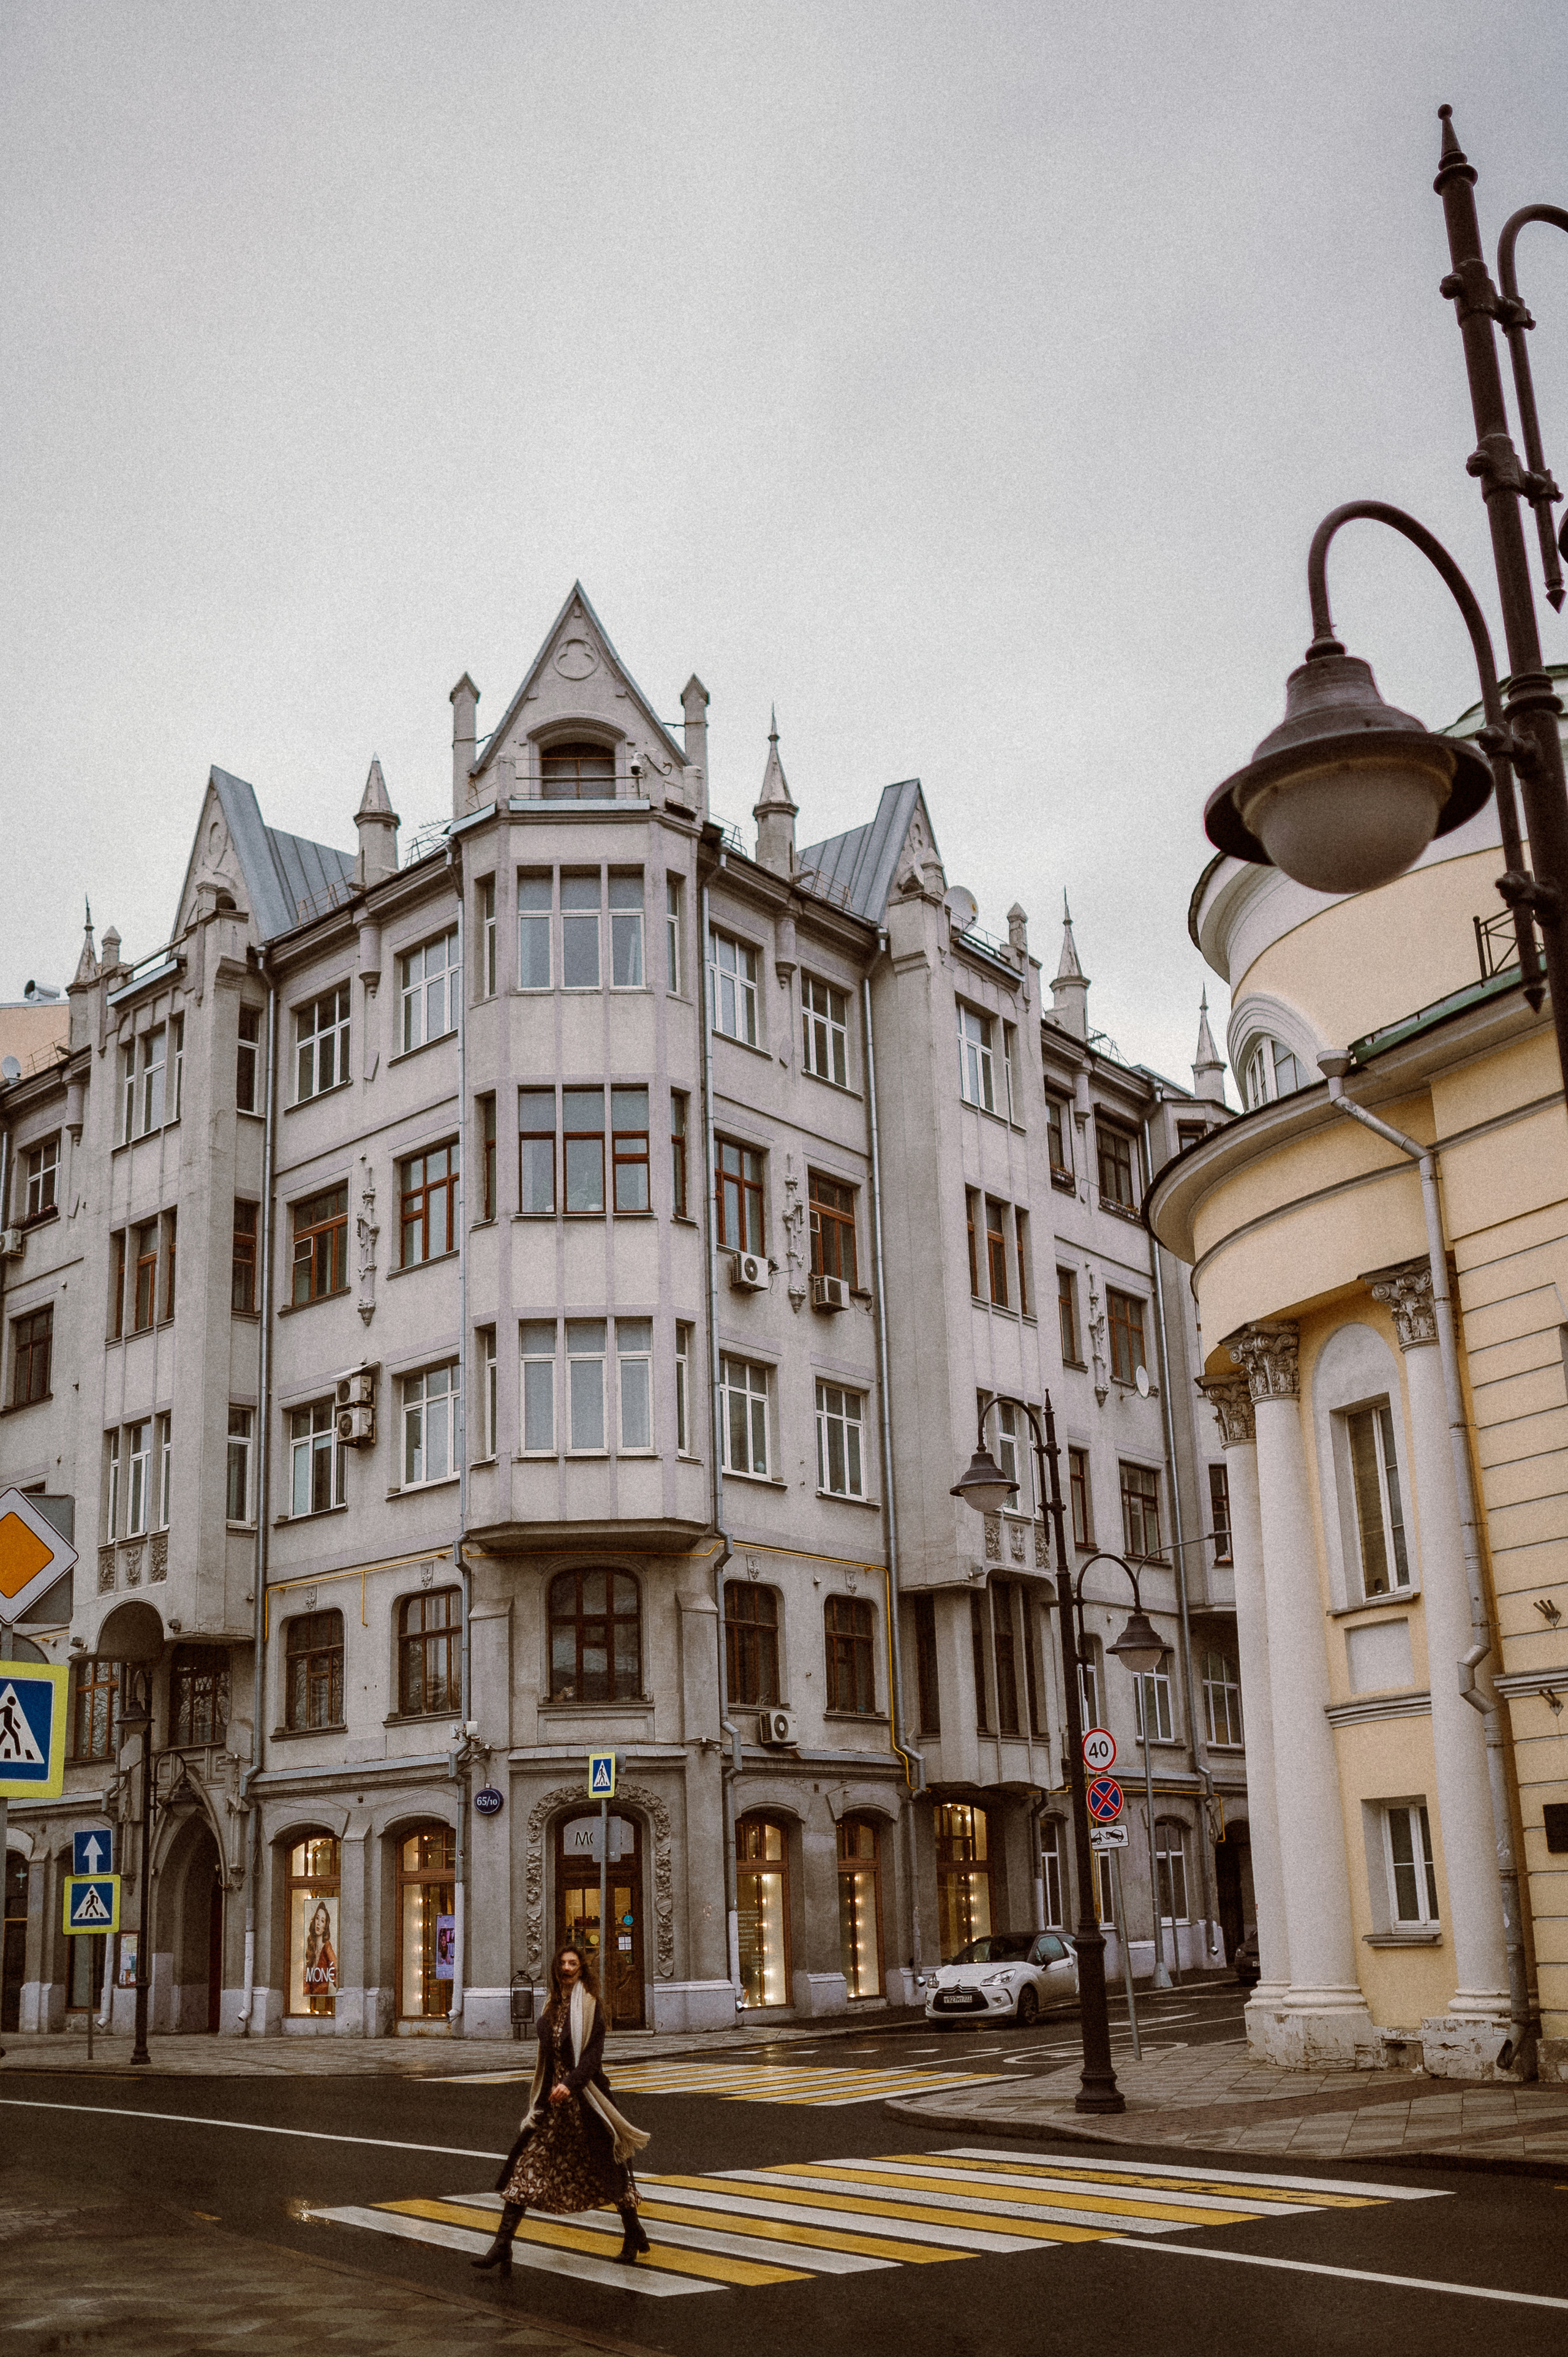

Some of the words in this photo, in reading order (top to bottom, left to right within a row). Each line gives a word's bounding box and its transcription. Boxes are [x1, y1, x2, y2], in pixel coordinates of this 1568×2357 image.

[1088, 1740, 1109, 1759] 40
[477, 1796, 497, 1806] 65/10
[306, 1961, 335, 1983] MONÉ
